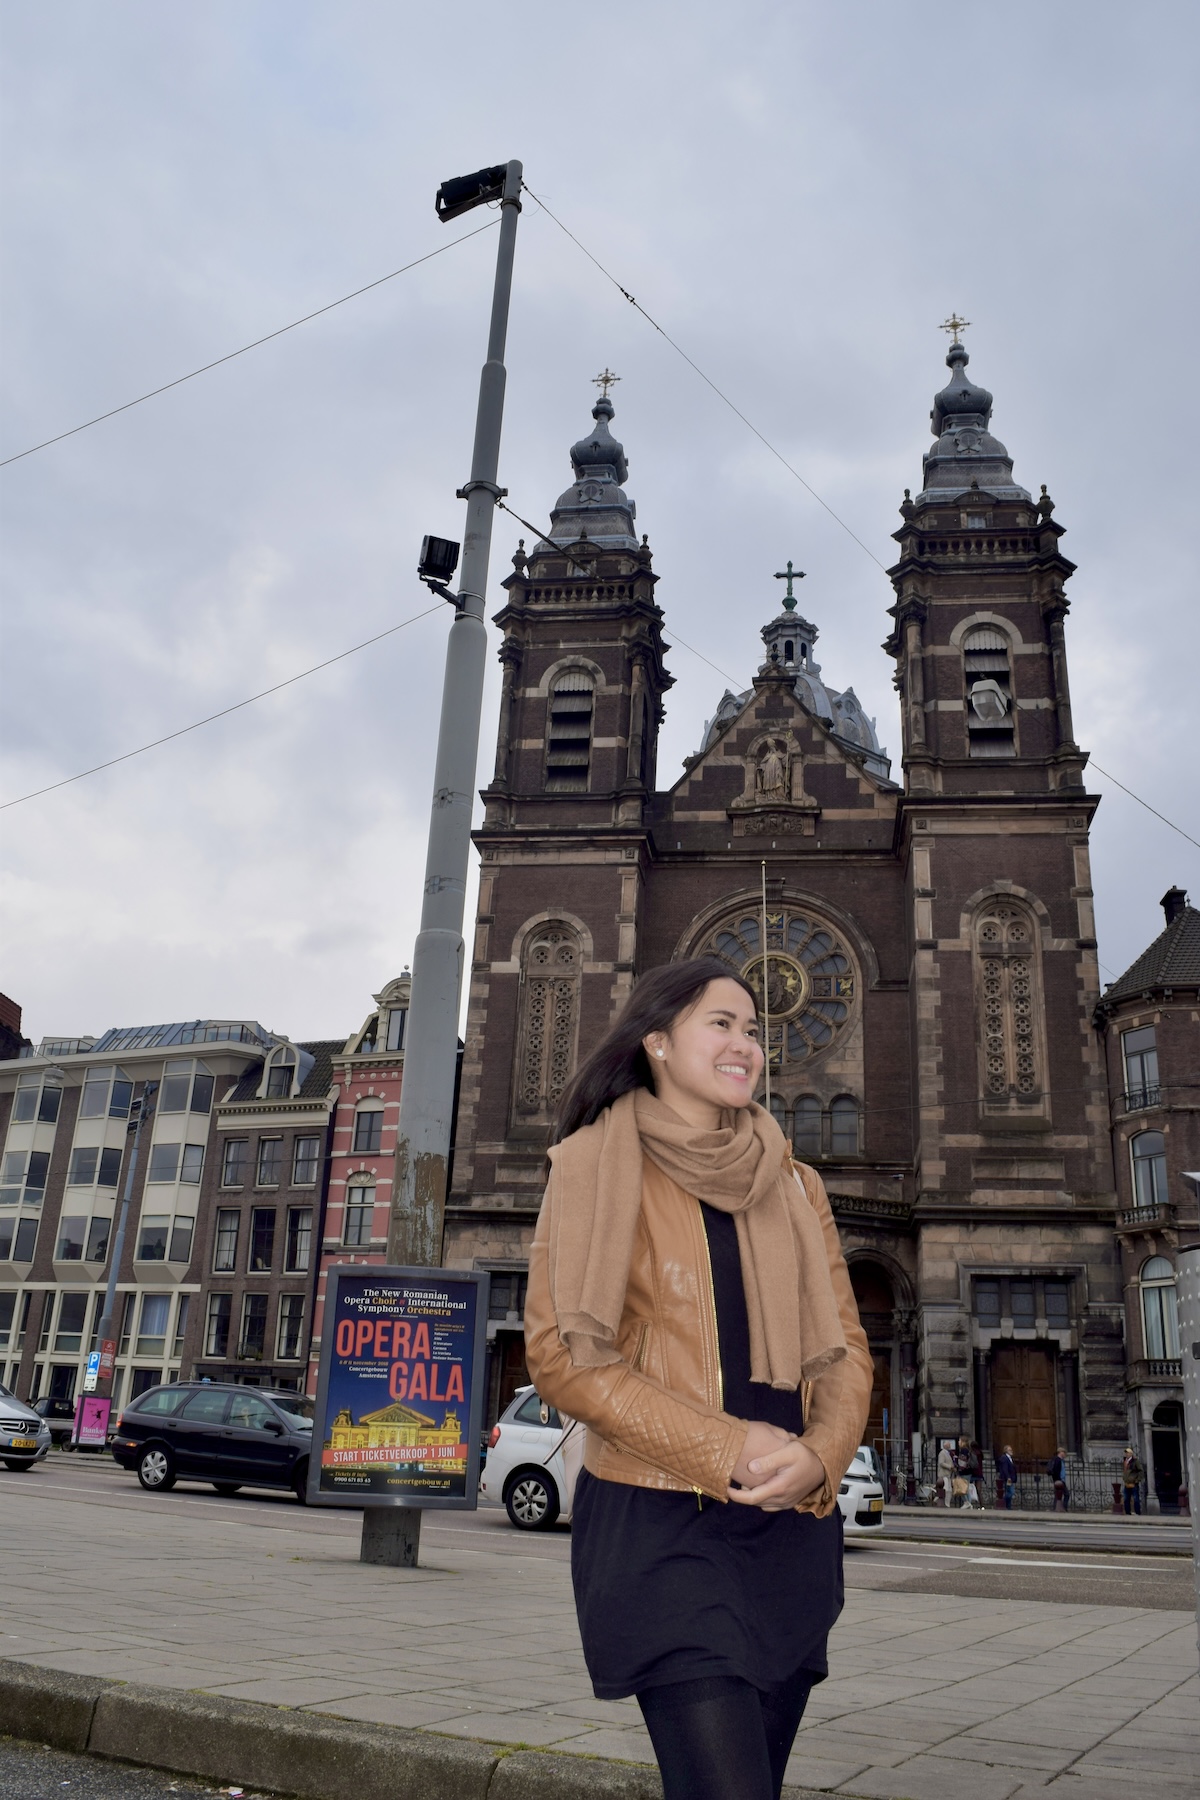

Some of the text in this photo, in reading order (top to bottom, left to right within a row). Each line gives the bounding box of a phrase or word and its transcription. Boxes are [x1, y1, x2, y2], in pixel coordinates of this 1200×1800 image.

[403, 1290, 448, 1300] Romanian
[344, 1297, 370, 1306] Opera
[408, 1298, 467, 1310] International
[358, 1304, 452, 1316] Symphony Orchestra
[336, 1319, 430, 1360] OPERA
[90, 1354, 98, 1366] P
[389, 1362, 465, 1402] GALA
[334, 1447, 455, 1462] START TICKETVERKOOP 1 JUNI
[387, 1478, 451, 1486] concertgebouw.nl
